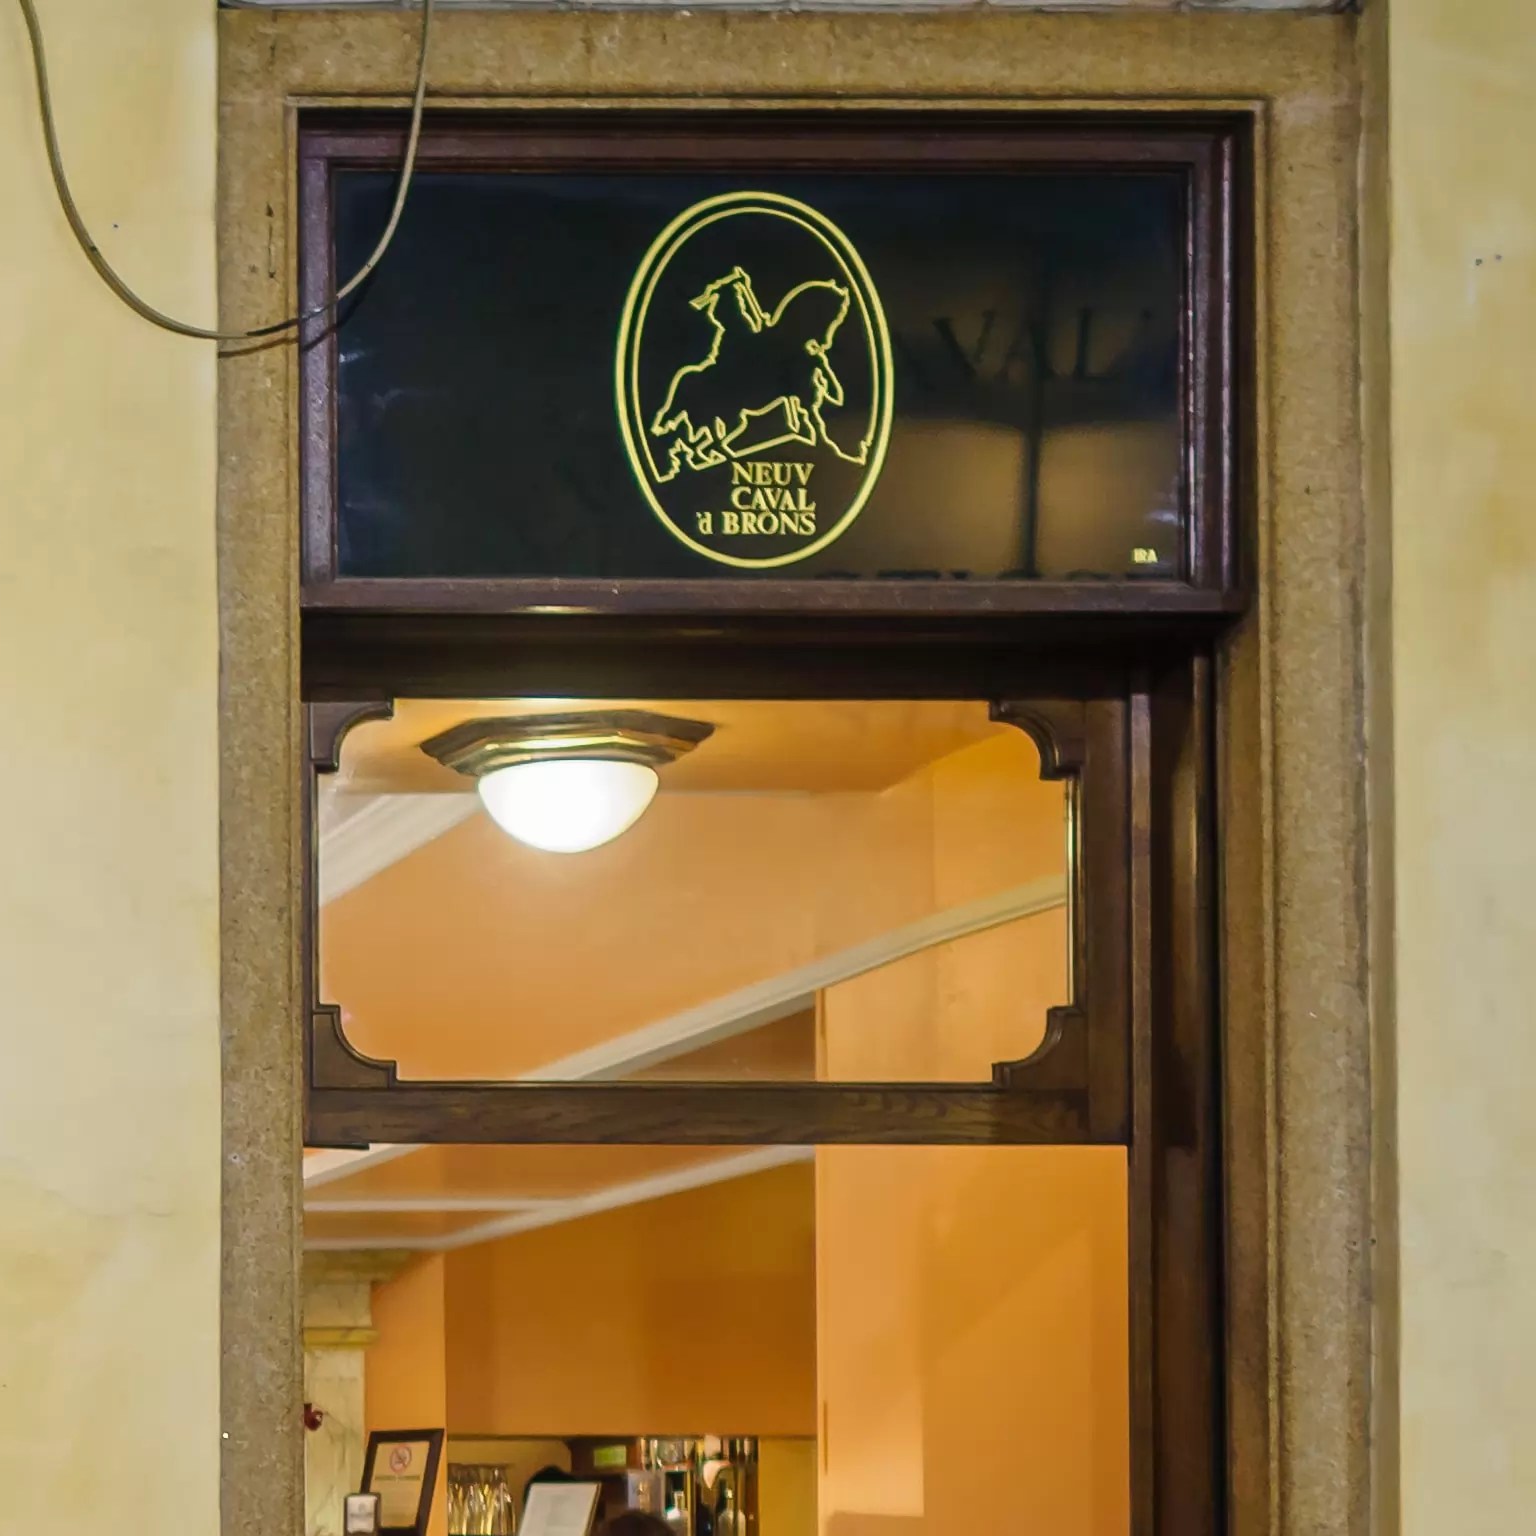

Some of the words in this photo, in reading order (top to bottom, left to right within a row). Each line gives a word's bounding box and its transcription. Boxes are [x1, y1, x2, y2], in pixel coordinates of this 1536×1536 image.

[731, 462, 814, 486] NEUV
[731, 486, 816, 511] CAVAL
[722, 511, 816, 535] BRONS
